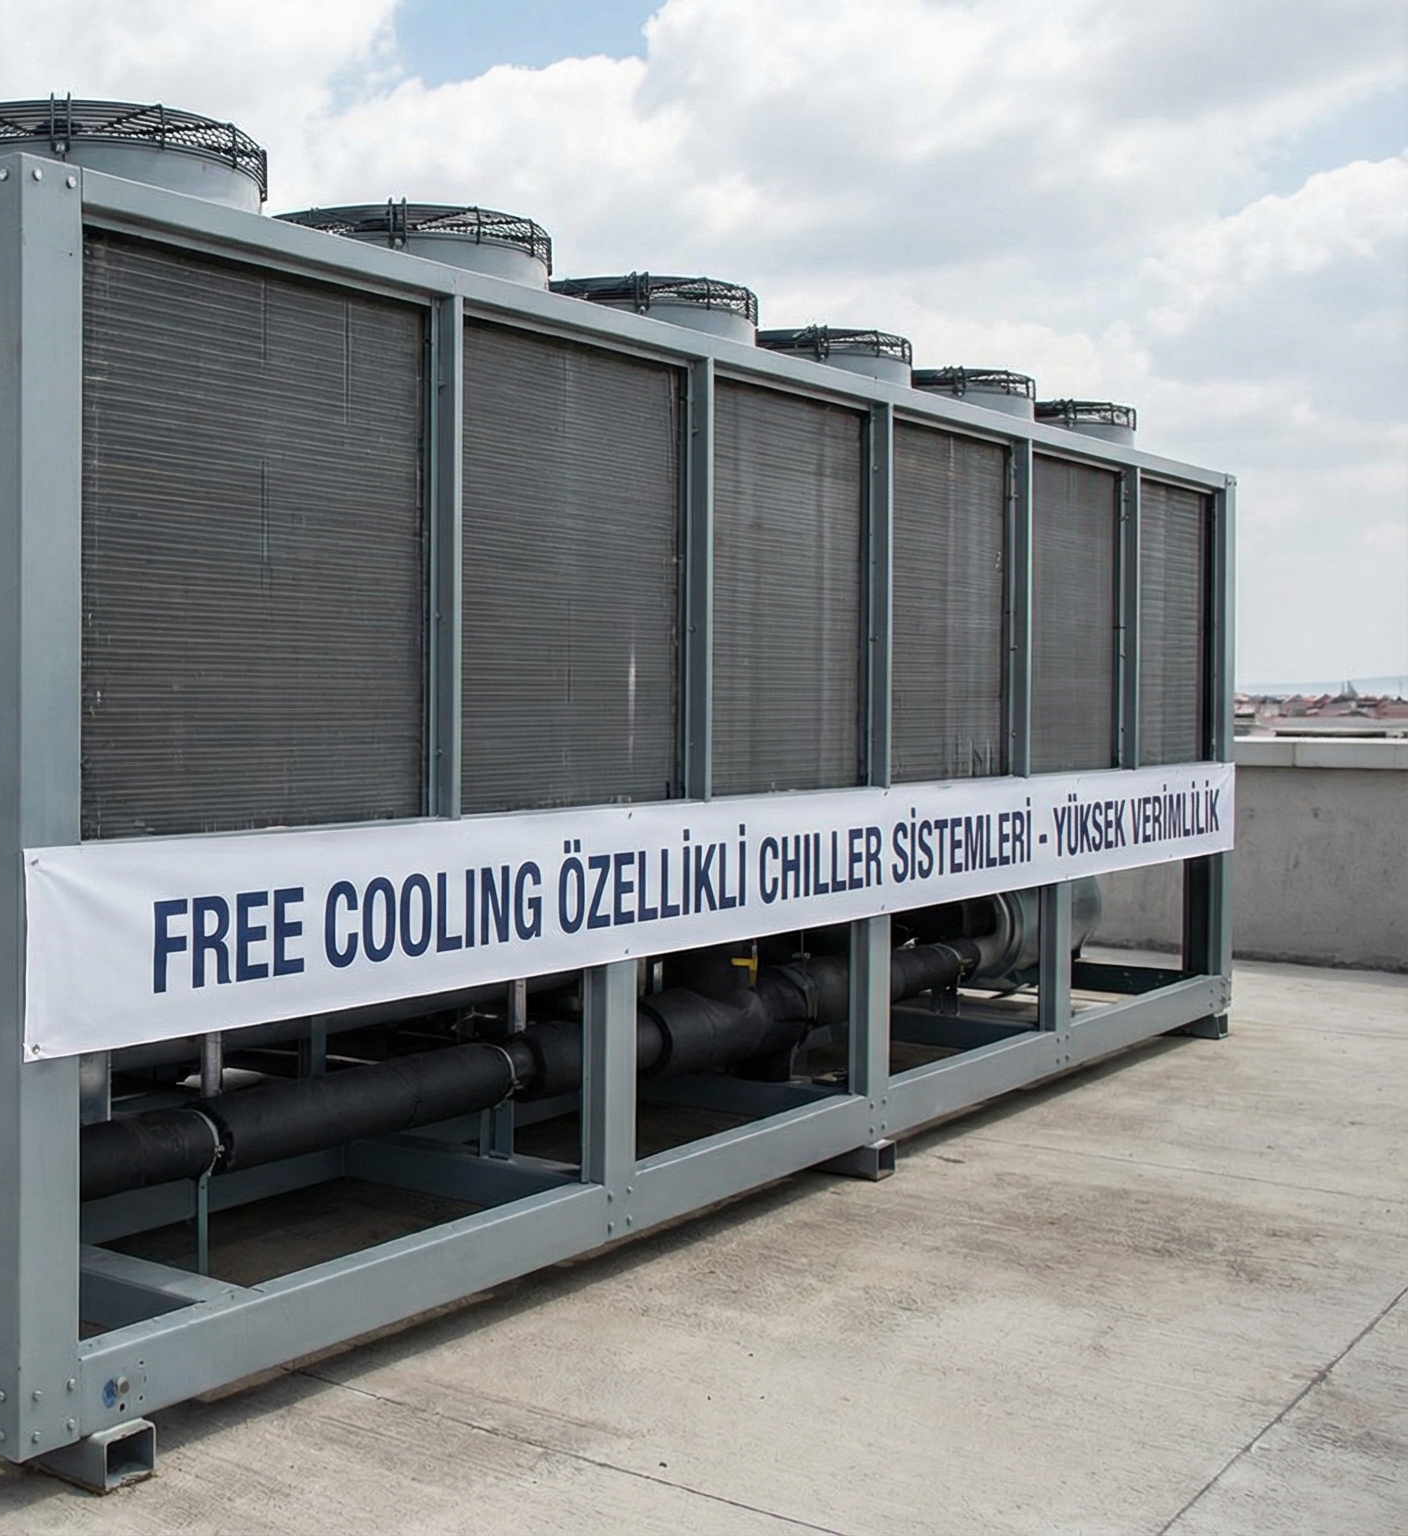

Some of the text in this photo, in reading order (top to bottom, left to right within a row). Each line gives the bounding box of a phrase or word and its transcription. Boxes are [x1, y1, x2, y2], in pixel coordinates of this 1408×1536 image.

[153, 779, 1220, 994] FREE COOLING ÖZELLİKLİ CHILLER SİSTEMLERİ - YÜKSEK VERİMLİLİK
